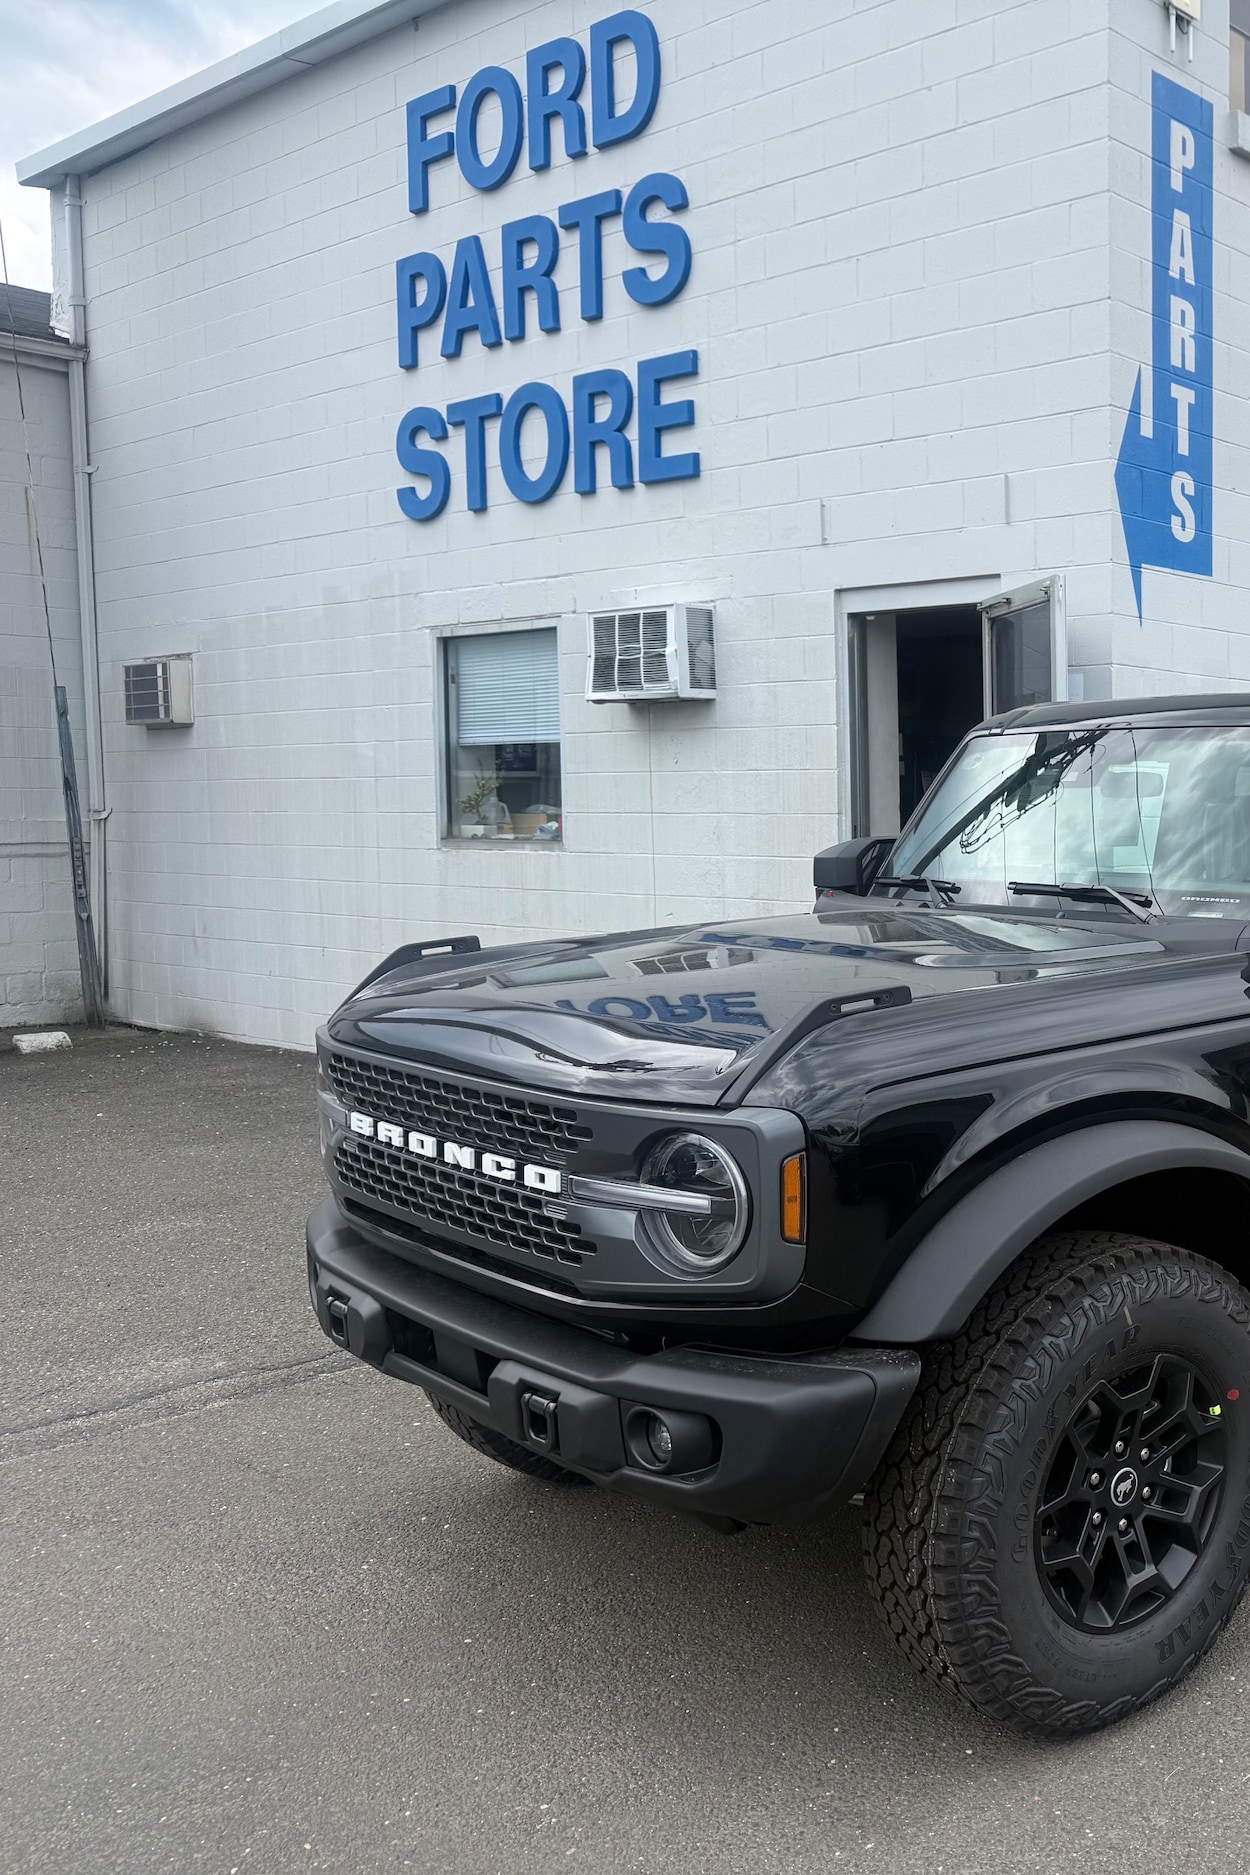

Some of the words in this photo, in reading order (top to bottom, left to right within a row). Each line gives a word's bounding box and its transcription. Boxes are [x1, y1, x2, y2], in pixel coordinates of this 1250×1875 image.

[407, 10, 660, 214] FORD
[396, 172, 692, 369] PARTS
[1168, 118, 1196, 543] PARTS
[396, 349, 700, 521] STORE
[1181, 895, 1240, 904] BRONCO
[350, 1111, 562, 1194] BRONCO
